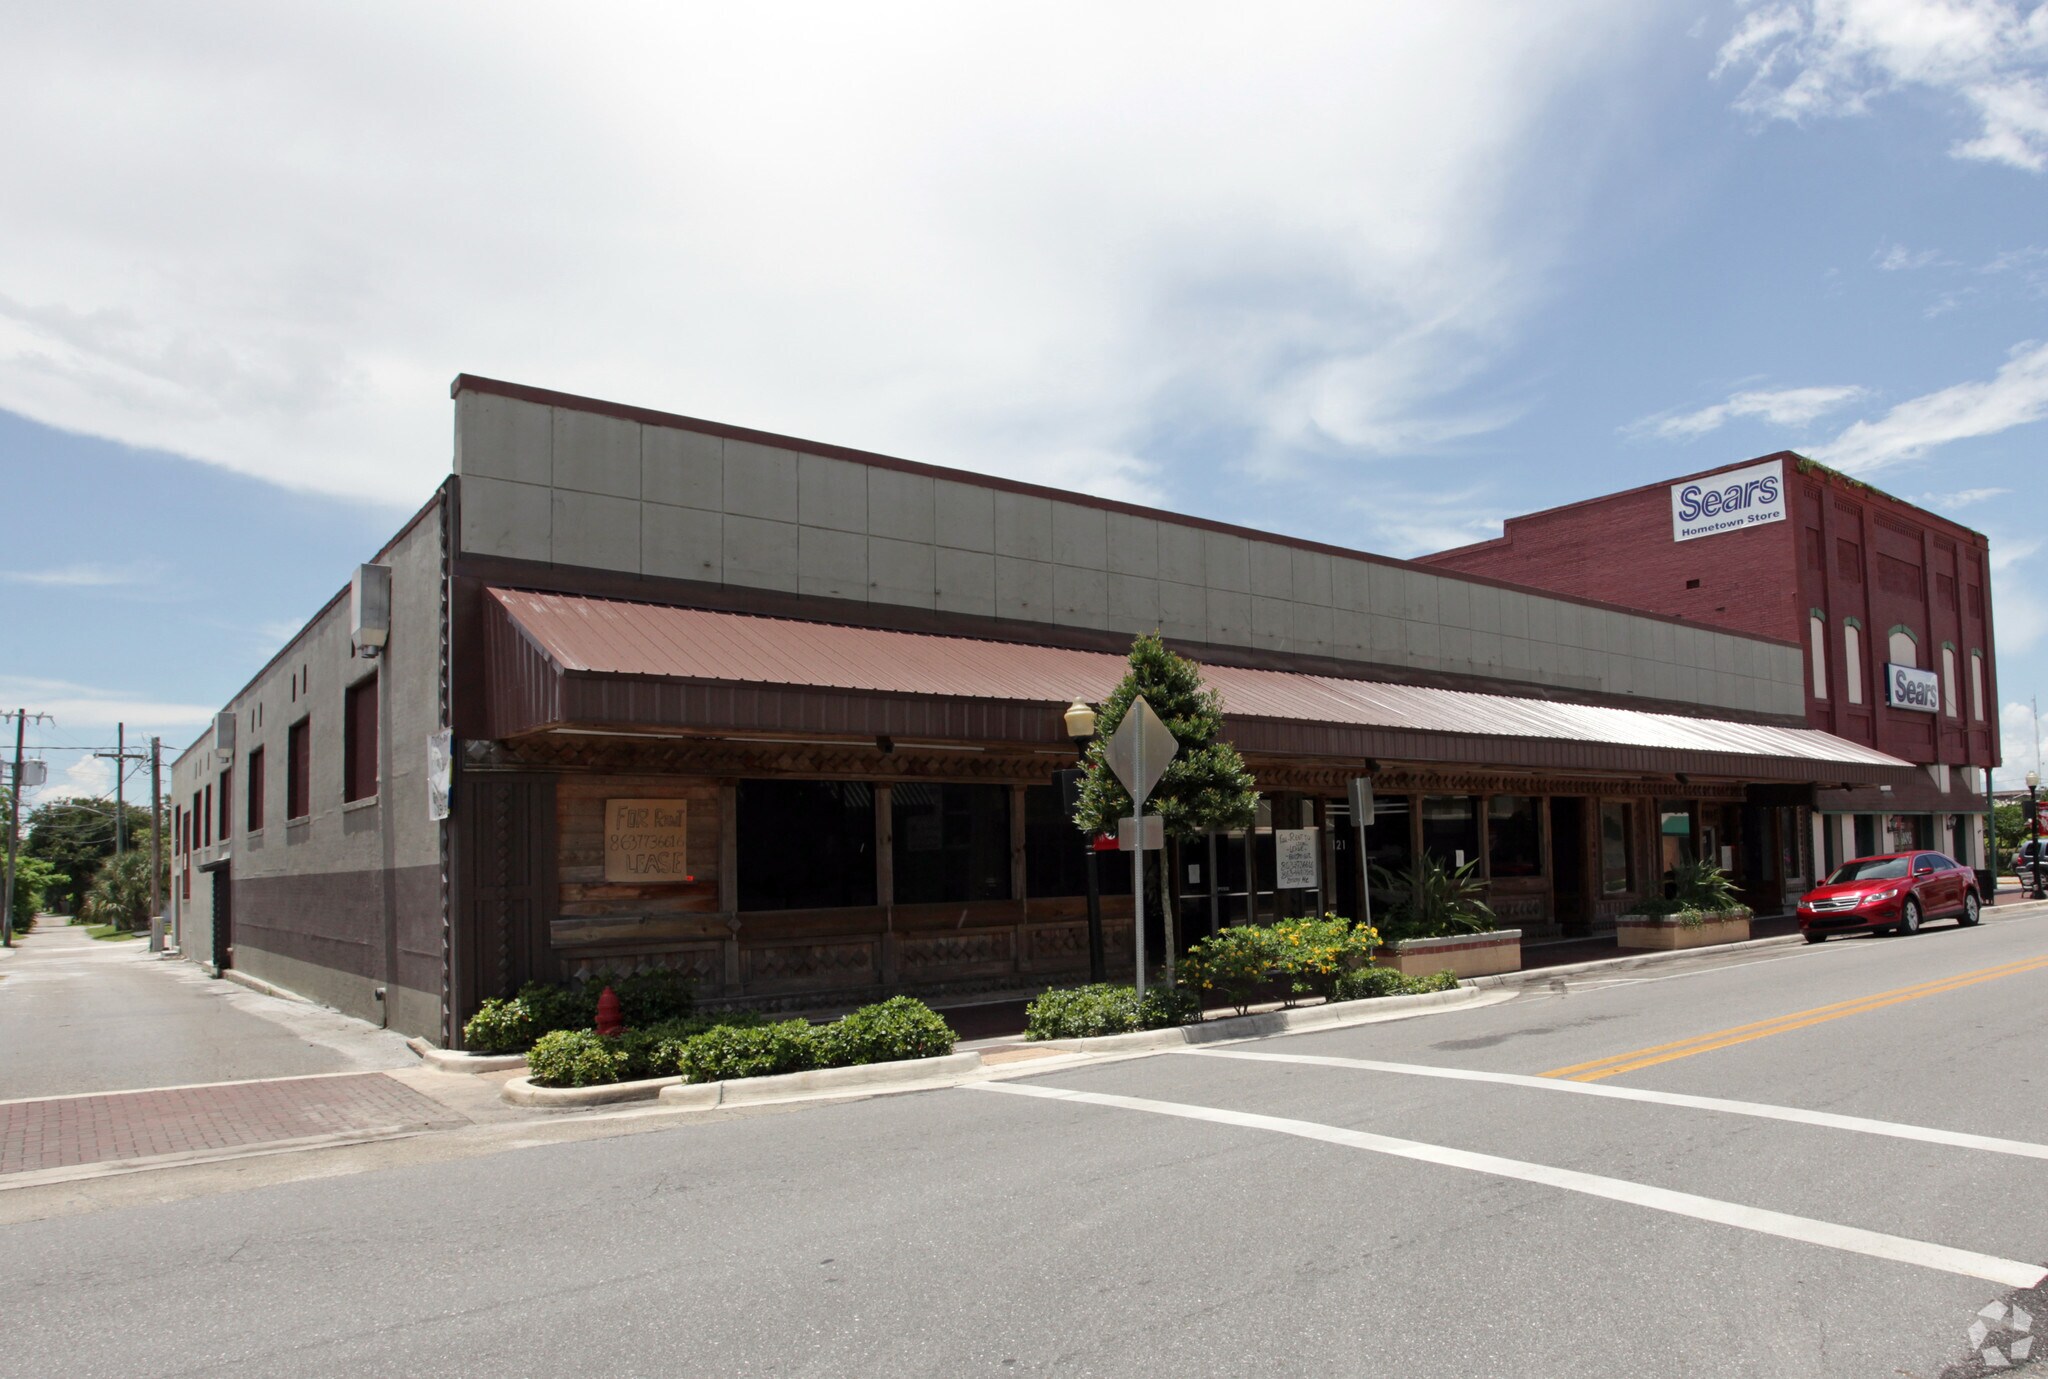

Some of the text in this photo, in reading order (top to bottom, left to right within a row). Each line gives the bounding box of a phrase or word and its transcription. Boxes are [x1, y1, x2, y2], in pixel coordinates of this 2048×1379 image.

[1679, 476, 1778, 522] Sears
[1682, 510, 1780, 537] Hometown Store
[1895, 669, 1937, 708] Sears
[616, 806, 650, 831] FOR
[626, 851, 684, 874] LEASE
